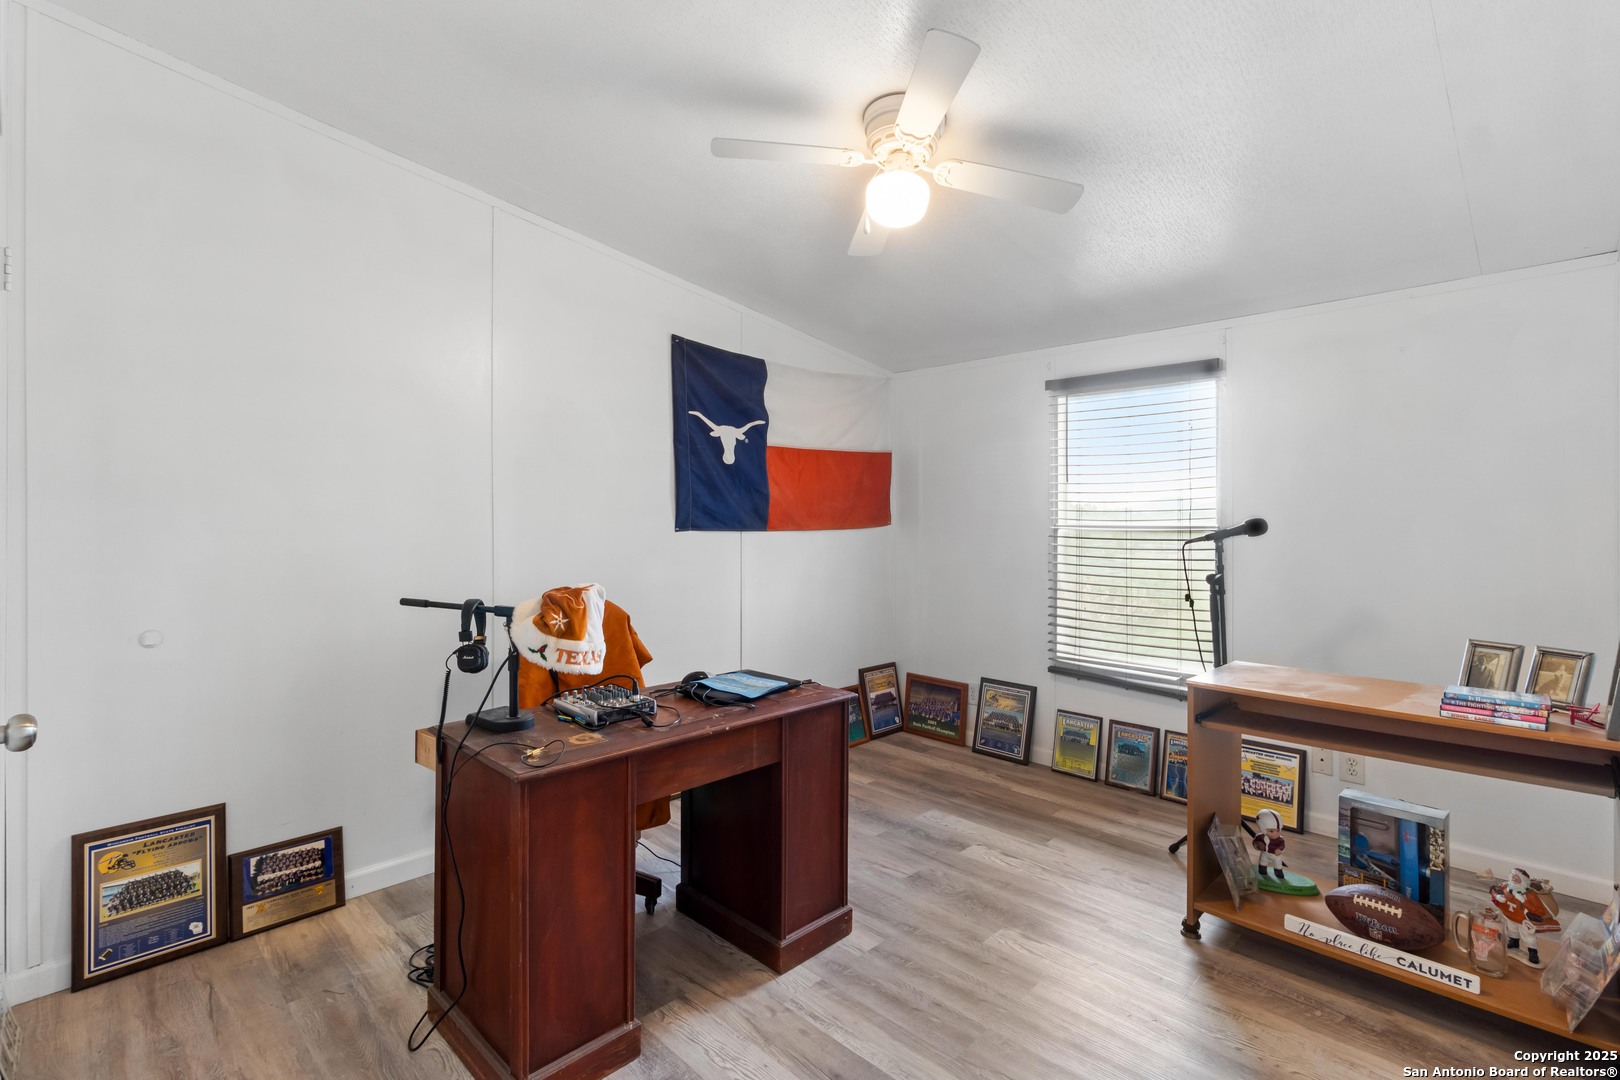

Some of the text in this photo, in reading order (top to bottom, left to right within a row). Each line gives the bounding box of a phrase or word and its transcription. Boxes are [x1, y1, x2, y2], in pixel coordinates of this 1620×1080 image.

[1467, 701, 1495, 710] FIGHTING
[1062, 718, 1094, 729] LANCASTER
[1117, 730, 1149, 741] LANCASTER
[143, 831, 196, 848] LANCASTER
[1507, 901, 1517, 912] T
[1355, 912, 1399, 935] Wilson
[1297, 921, 1473, 989] No place like CALUMET
